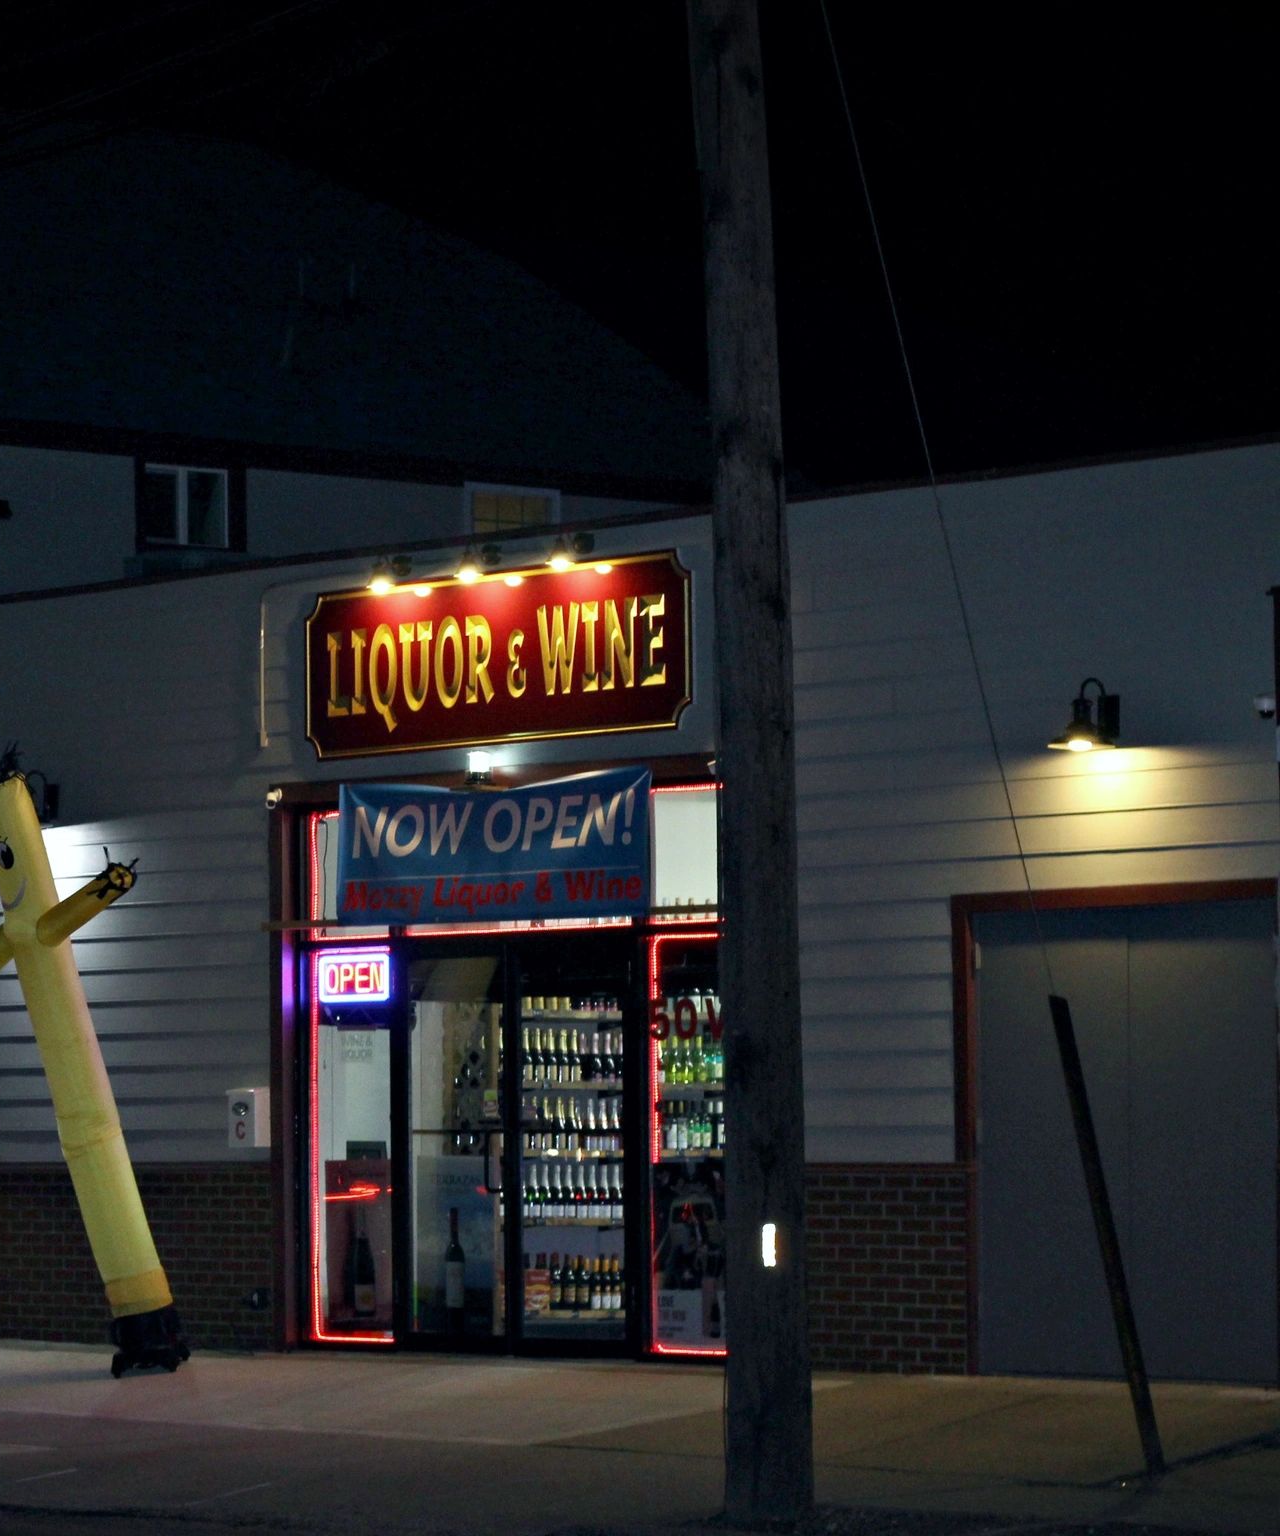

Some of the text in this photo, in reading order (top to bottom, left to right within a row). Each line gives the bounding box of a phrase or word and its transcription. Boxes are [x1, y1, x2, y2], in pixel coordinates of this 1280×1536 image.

[327, 593, 666, 733] LIQUOR & WINE
[352, 788, 635, 859] NOW OPEN!
[432, 874, 526, 915] Liquor
[534, 871, 554, 902] &
[564, 869, 642, 902] Wine
[325, 963, 385, 994] OPEN
[235, 1120, 246, 1140] C
